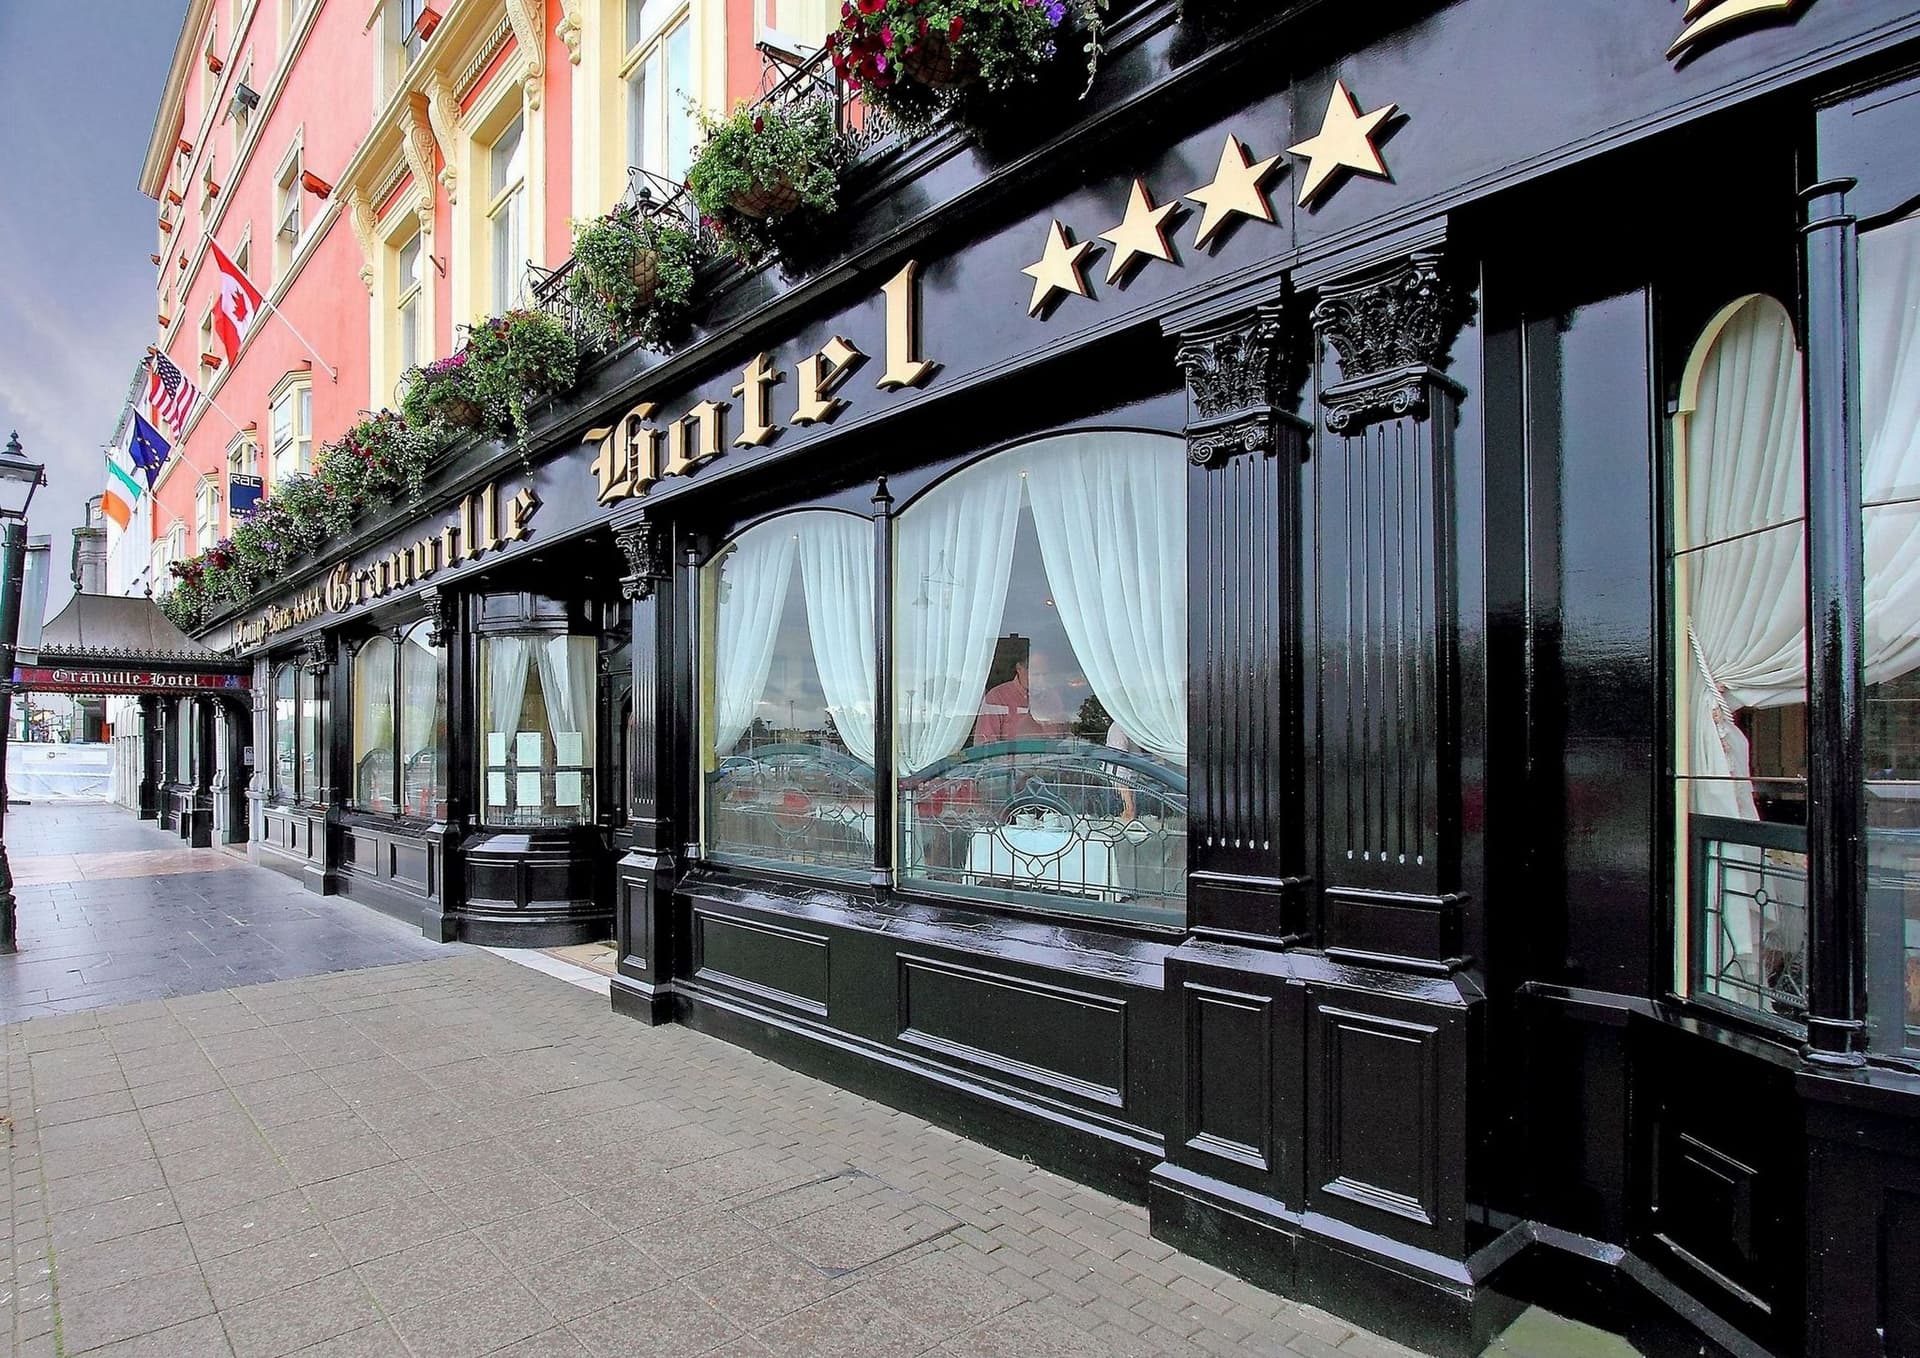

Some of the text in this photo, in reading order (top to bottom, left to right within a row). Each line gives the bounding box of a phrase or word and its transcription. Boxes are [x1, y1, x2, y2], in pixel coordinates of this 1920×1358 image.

[325, 259, 934, 614] Granville Hotel
[52, 669, 199, 687] Granville Hotel
